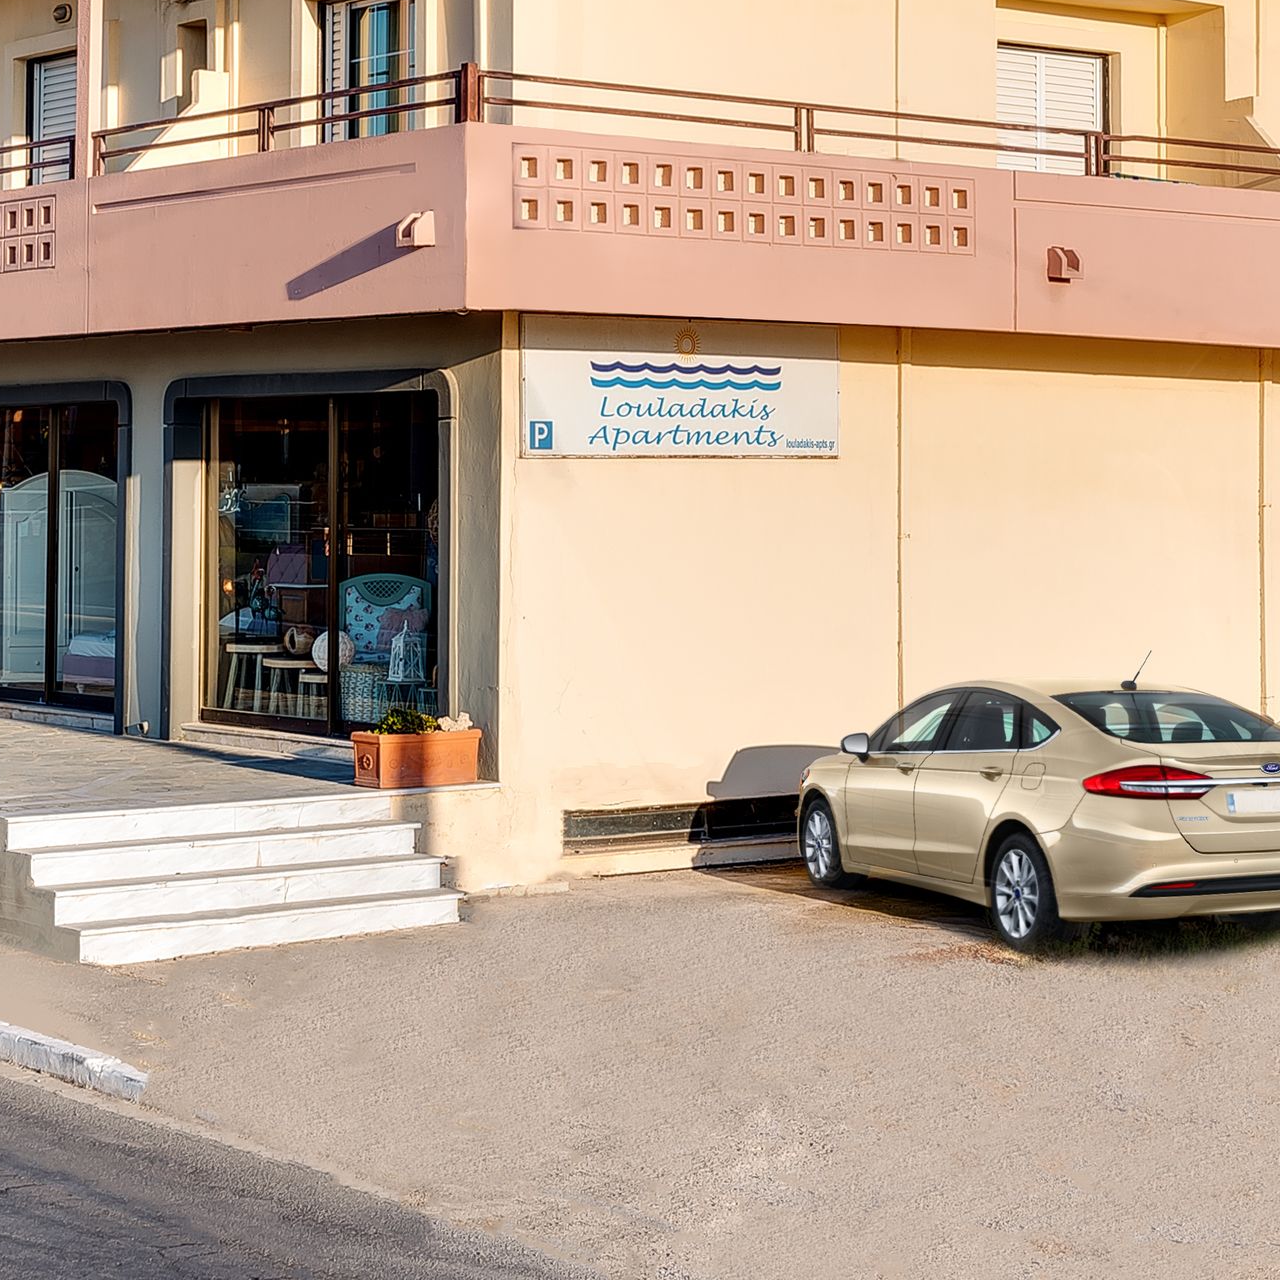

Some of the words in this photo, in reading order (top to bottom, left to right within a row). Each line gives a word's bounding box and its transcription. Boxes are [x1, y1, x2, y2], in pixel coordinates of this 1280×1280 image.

[600, 396, 776, 420] Louladakis
[588, 424, 785, 451] Apartments
[785, 438, 836, 451] louladakis-apts.gr
